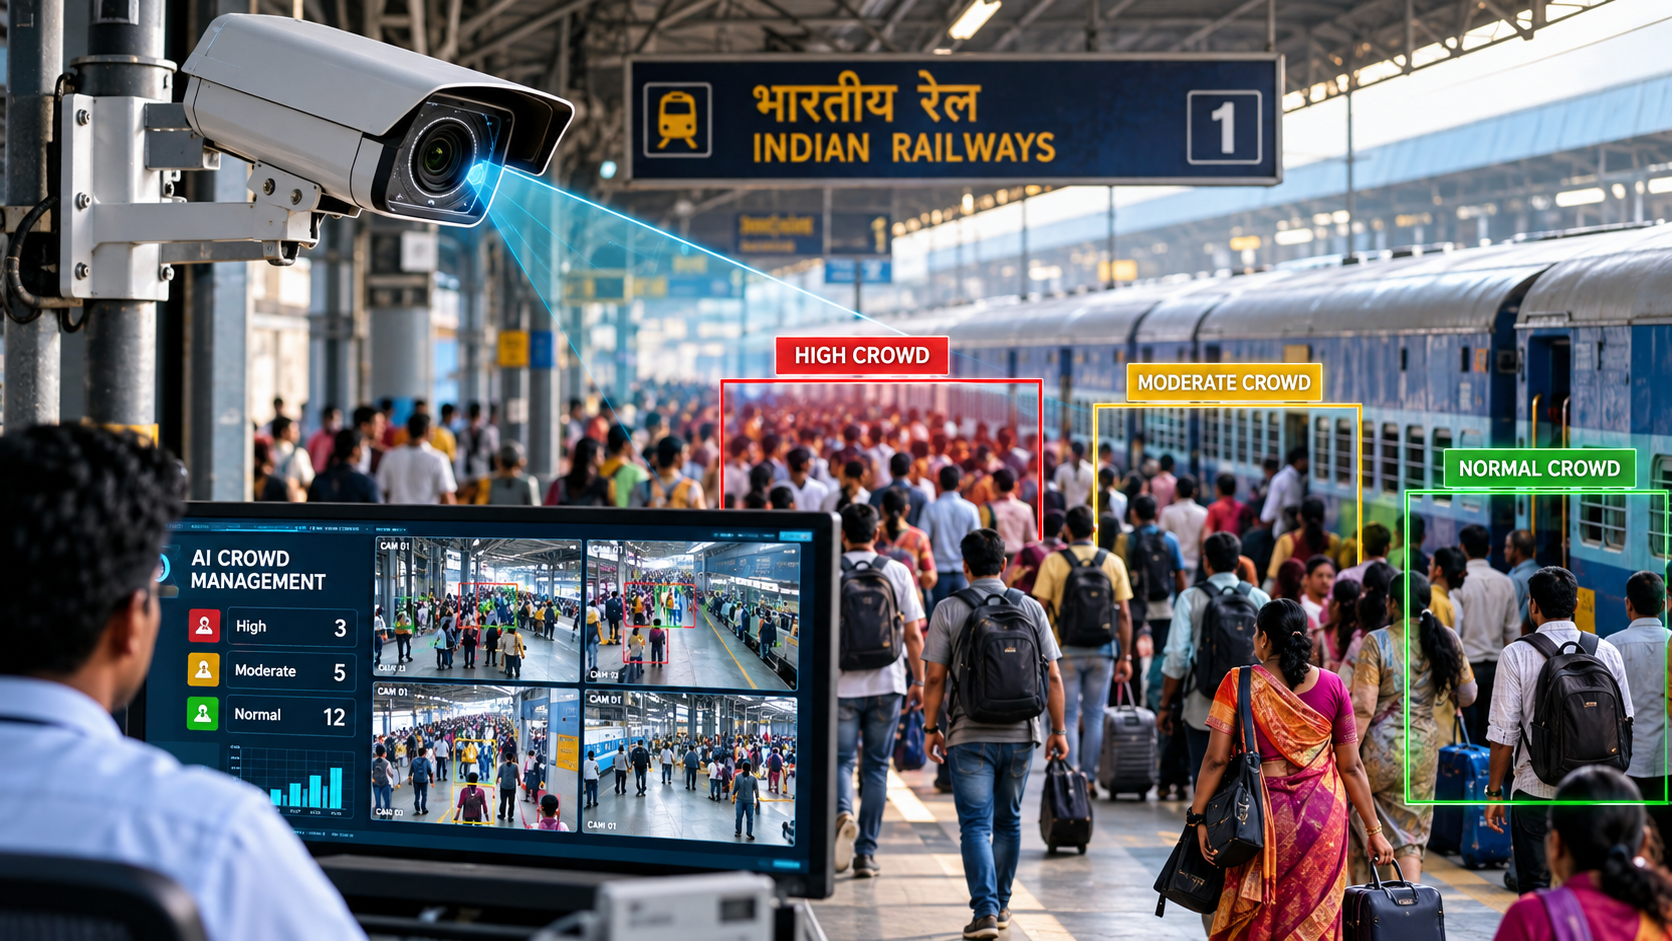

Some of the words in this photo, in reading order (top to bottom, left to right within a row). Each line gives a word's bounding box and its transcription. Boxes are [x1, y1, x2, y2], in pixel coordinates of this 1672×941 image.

[753, 70, 898, 122] भारतीय
[917, 70, 981, 122] रेल
[1211, 102, 1235, 154] 1
[754, 132, 870, 163] INDIAN
[892, 131, 1056, 163] RAILWAYS
[380, 541, 398, 551] CAM
[191, 549, 212, 567] AI
[217, 549, 290, 567] CROWD
[191, 572, 327, 591] MANAGEMENT
[236, 618, 267, 635] High
[333, 618, 347, 638] 3
[235, 663, 297, 678] Moderate
[333, 663, 346, 682] 5
[377, 686, 396, 697] CAM
[589, 694, 609, 704] CAM
[234, 707, 282, 721] Normal
[322, 707, 346, 727] 12
